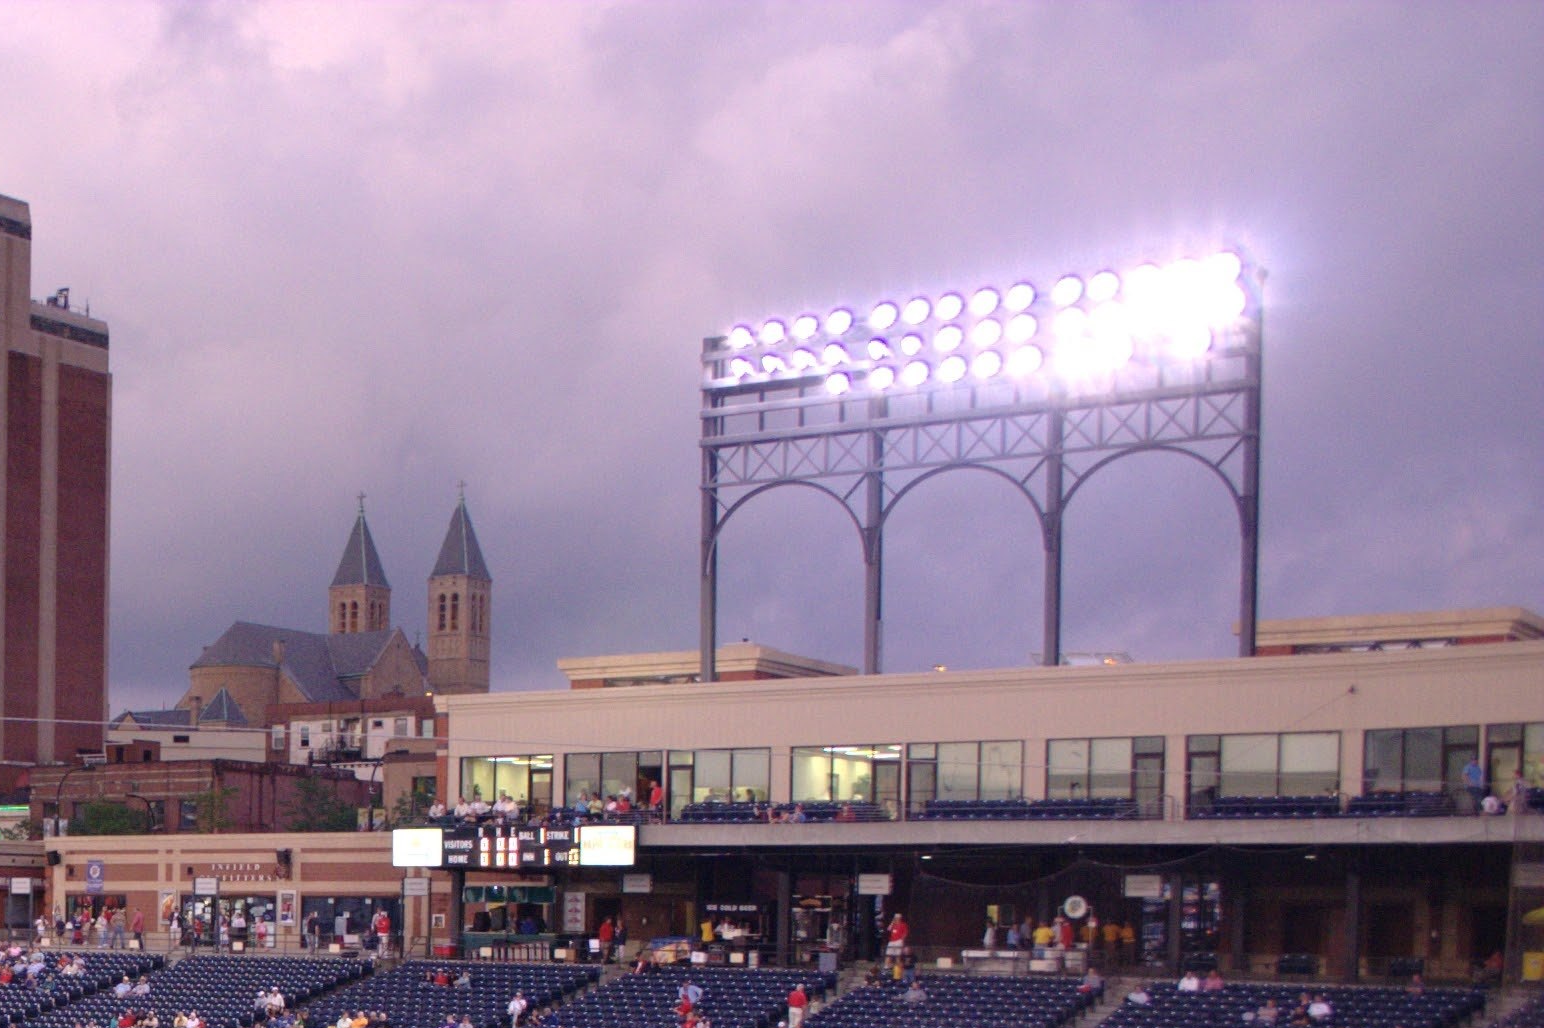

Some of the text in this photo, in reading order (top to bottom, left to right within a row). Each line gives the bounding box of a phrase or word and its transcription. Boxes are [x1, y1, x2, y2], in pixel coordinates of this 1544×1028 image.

[518, 831, 535, 840] BALL
[546, 831, 570, 840] STRIKE
[444, 840, 473, 849] VISITORS
[448, 854, 469, 863] HOME
[555, 852, 568, 860] OUT
[211, 863, 261, 871] INFIELD
